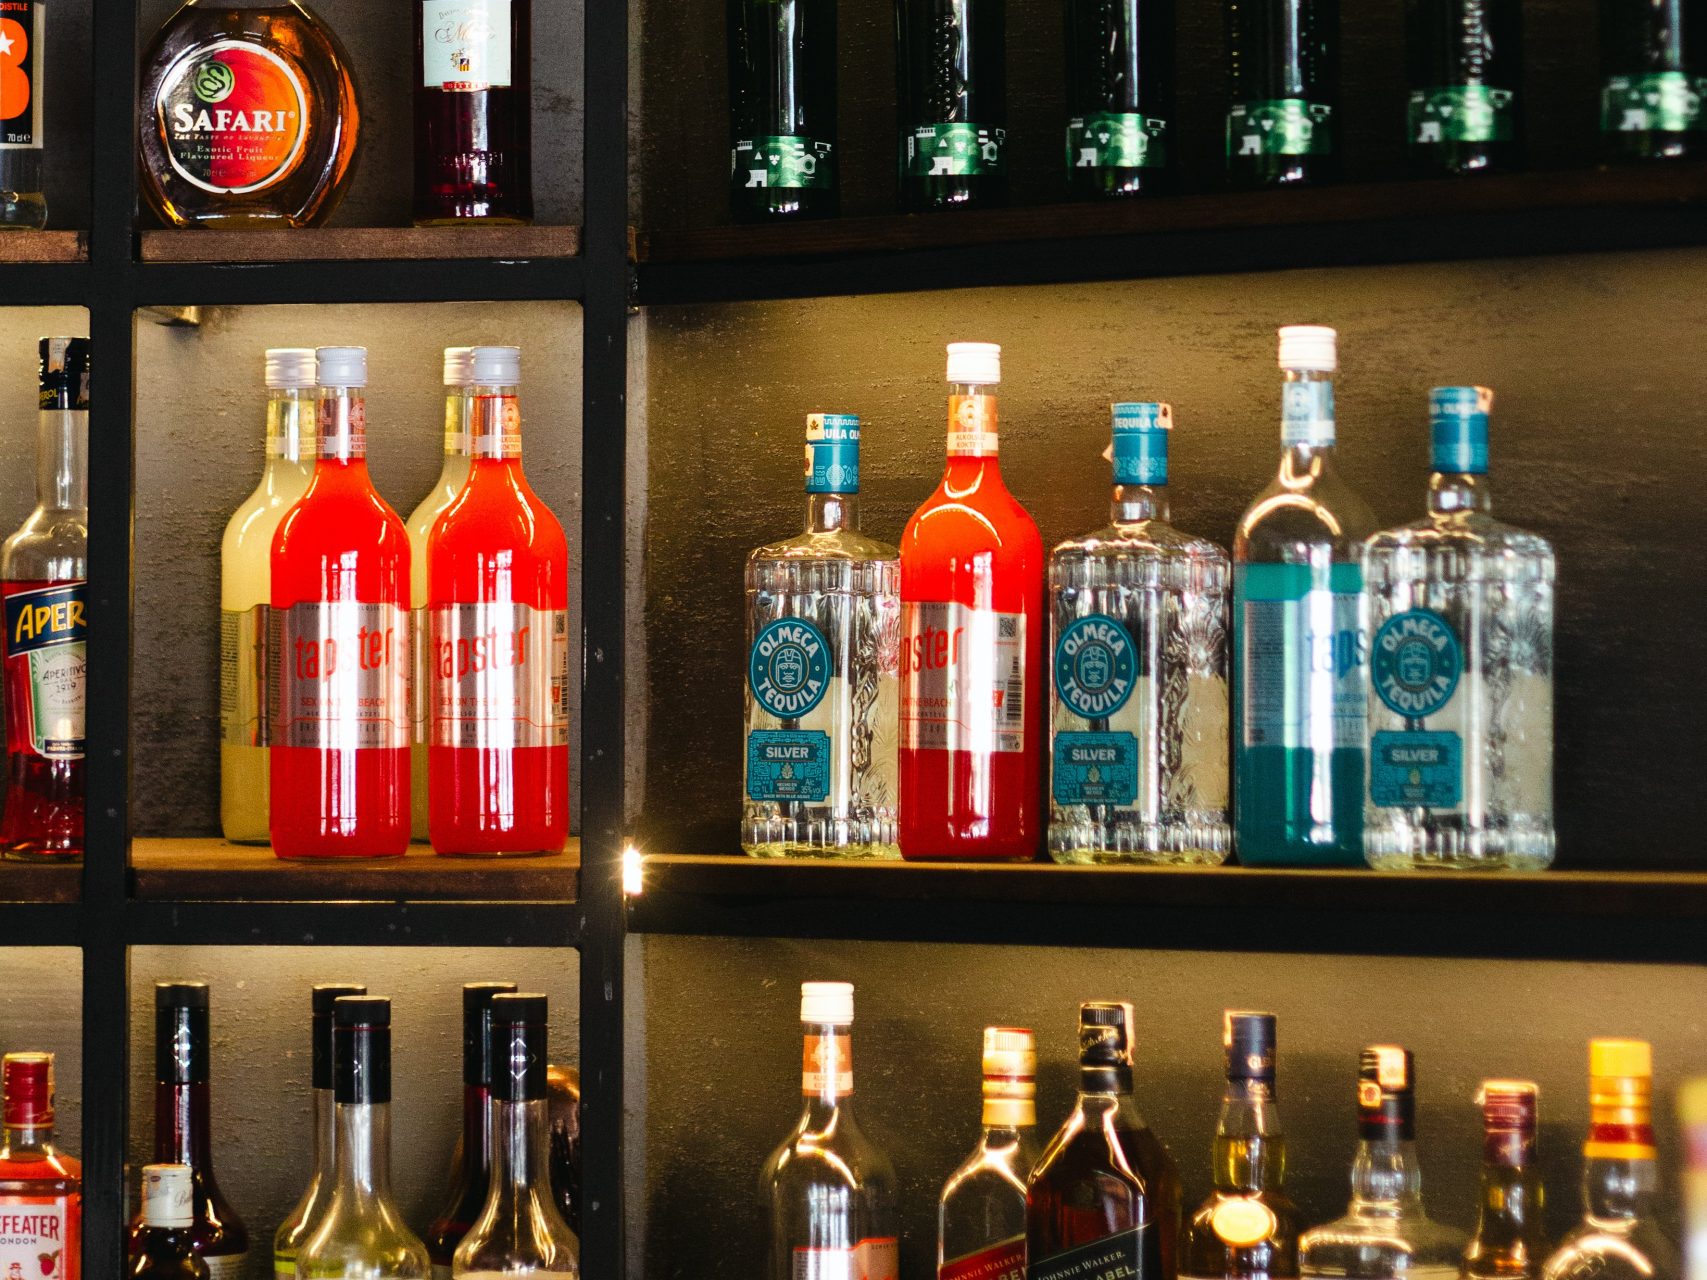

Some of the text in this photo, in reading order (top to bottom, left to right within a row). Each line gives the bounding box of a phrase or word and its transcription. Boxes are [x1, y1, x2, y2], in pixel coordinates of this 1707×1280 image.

[174, 103, 286, 133] SAFARI
[180, 152, 234, 161] Flavoured
[197, 145, 264, 153] Exotic Fruit
[758, 626, 820, 658] OLMECA
[1063, 623, 1126, 657] OLMECA
[1381, 618, 1449, 652] OLMECA
[757, 677, 822, 712] TEQUILA
[1063, 677, 1128, 713] TEQUILA
[1382, 674, 1451, 711] TEQUILA
[766, 746, 809, 758] SILVER
[1072, 749, 1116, 761] SILVER
[1391, 749, 1439, 762] SILVER
